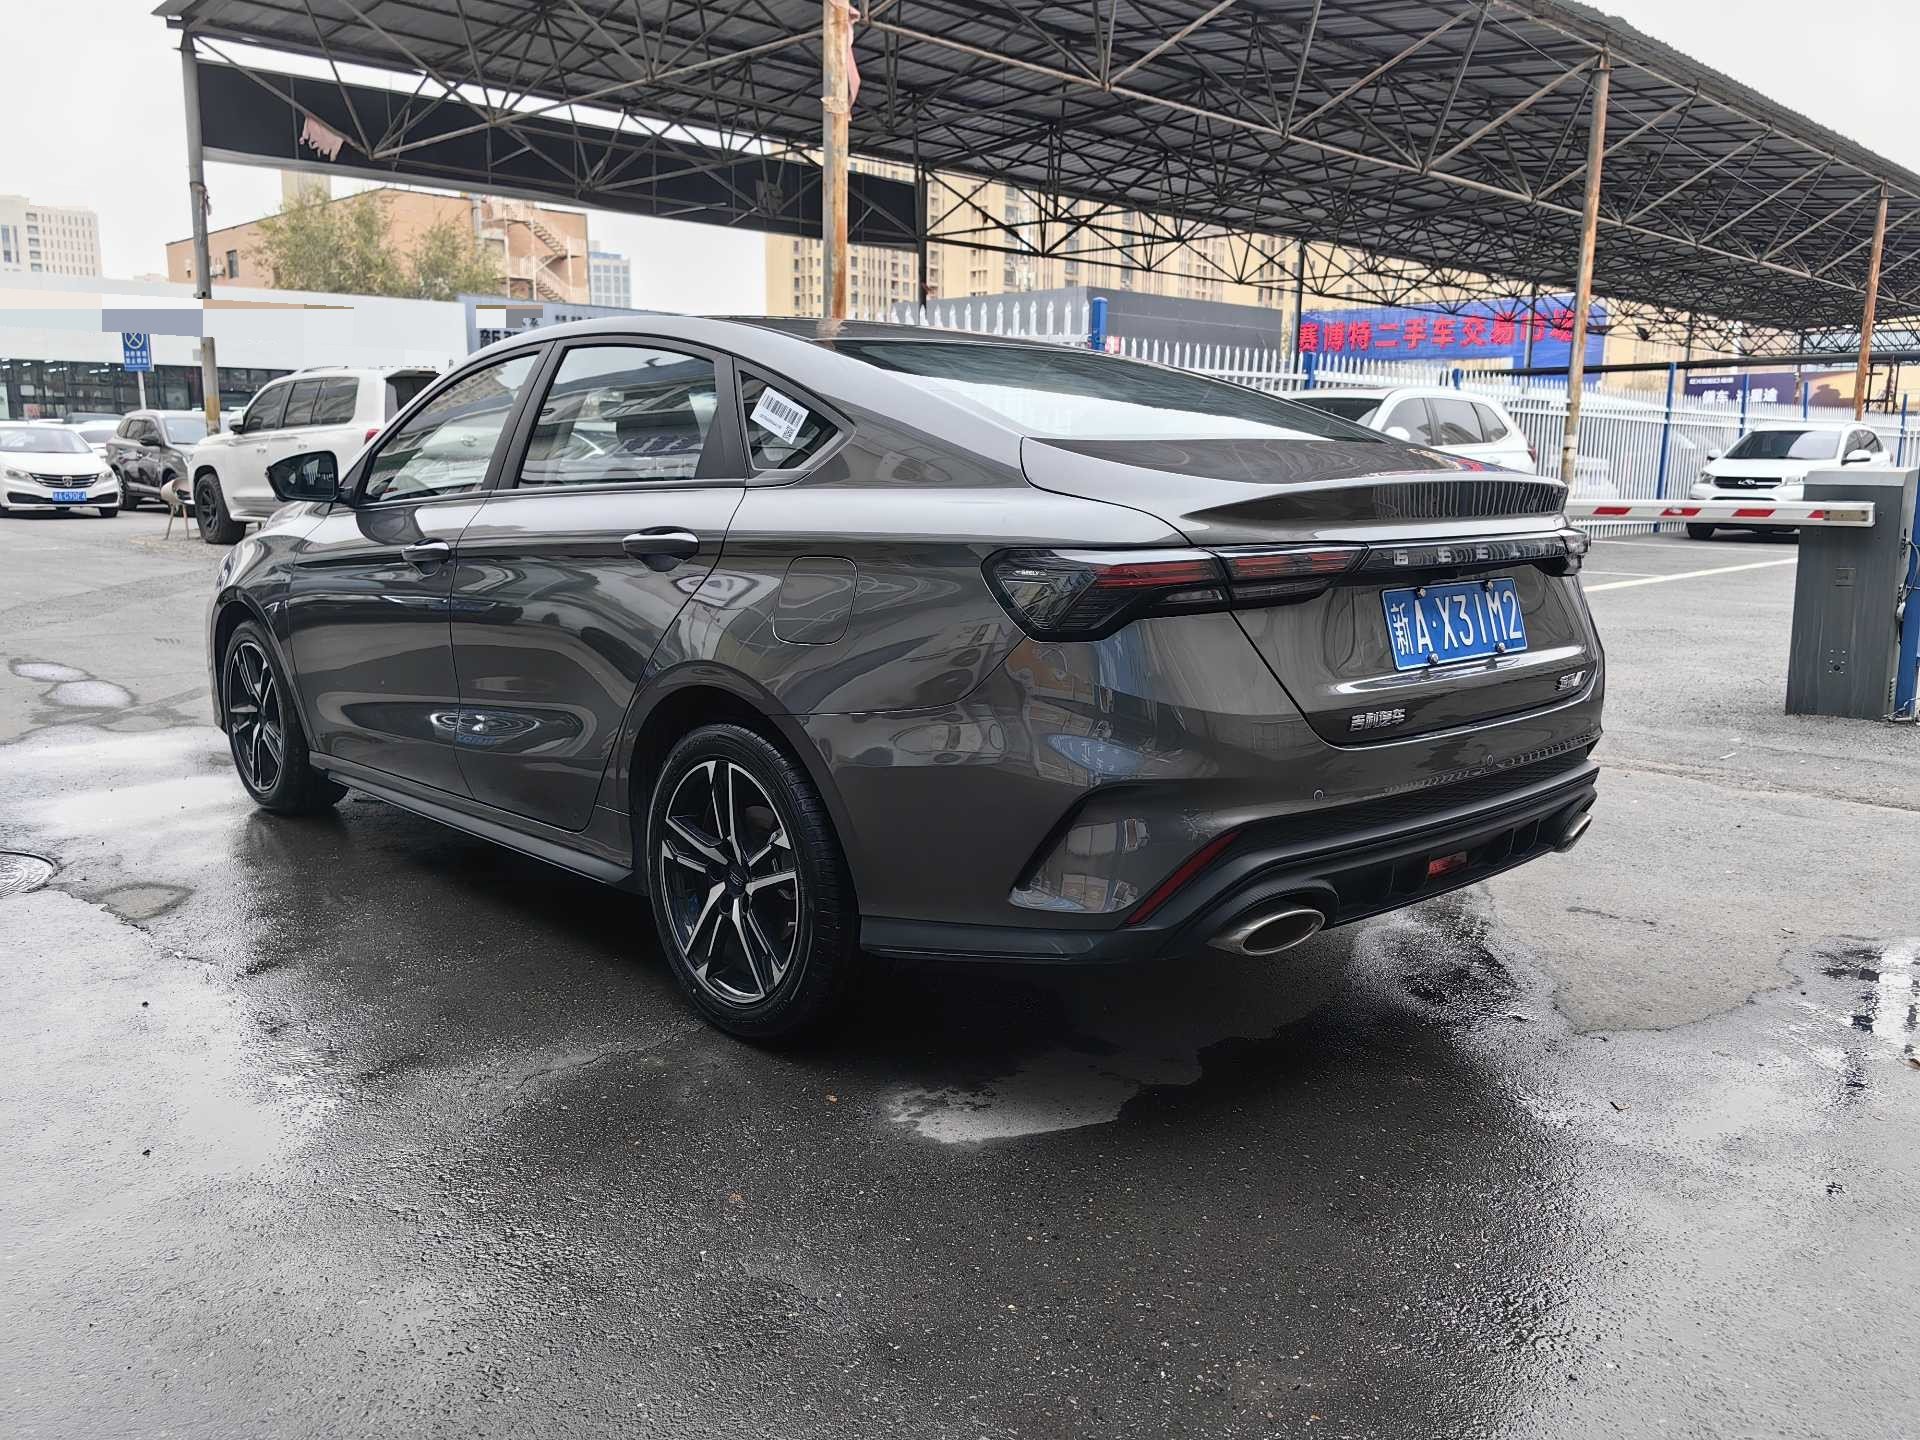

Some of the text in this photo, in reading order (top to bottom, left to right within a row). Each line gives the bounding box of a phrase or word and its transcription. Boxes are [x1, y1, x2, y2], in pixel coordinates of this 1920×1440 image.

[1299, 308, 1575, 352] 赛博特二手车交易市场
[1391, 590, 1523, 656] 新A·X31M2
[1349, 708, 1406, 731] 吉利汽车
